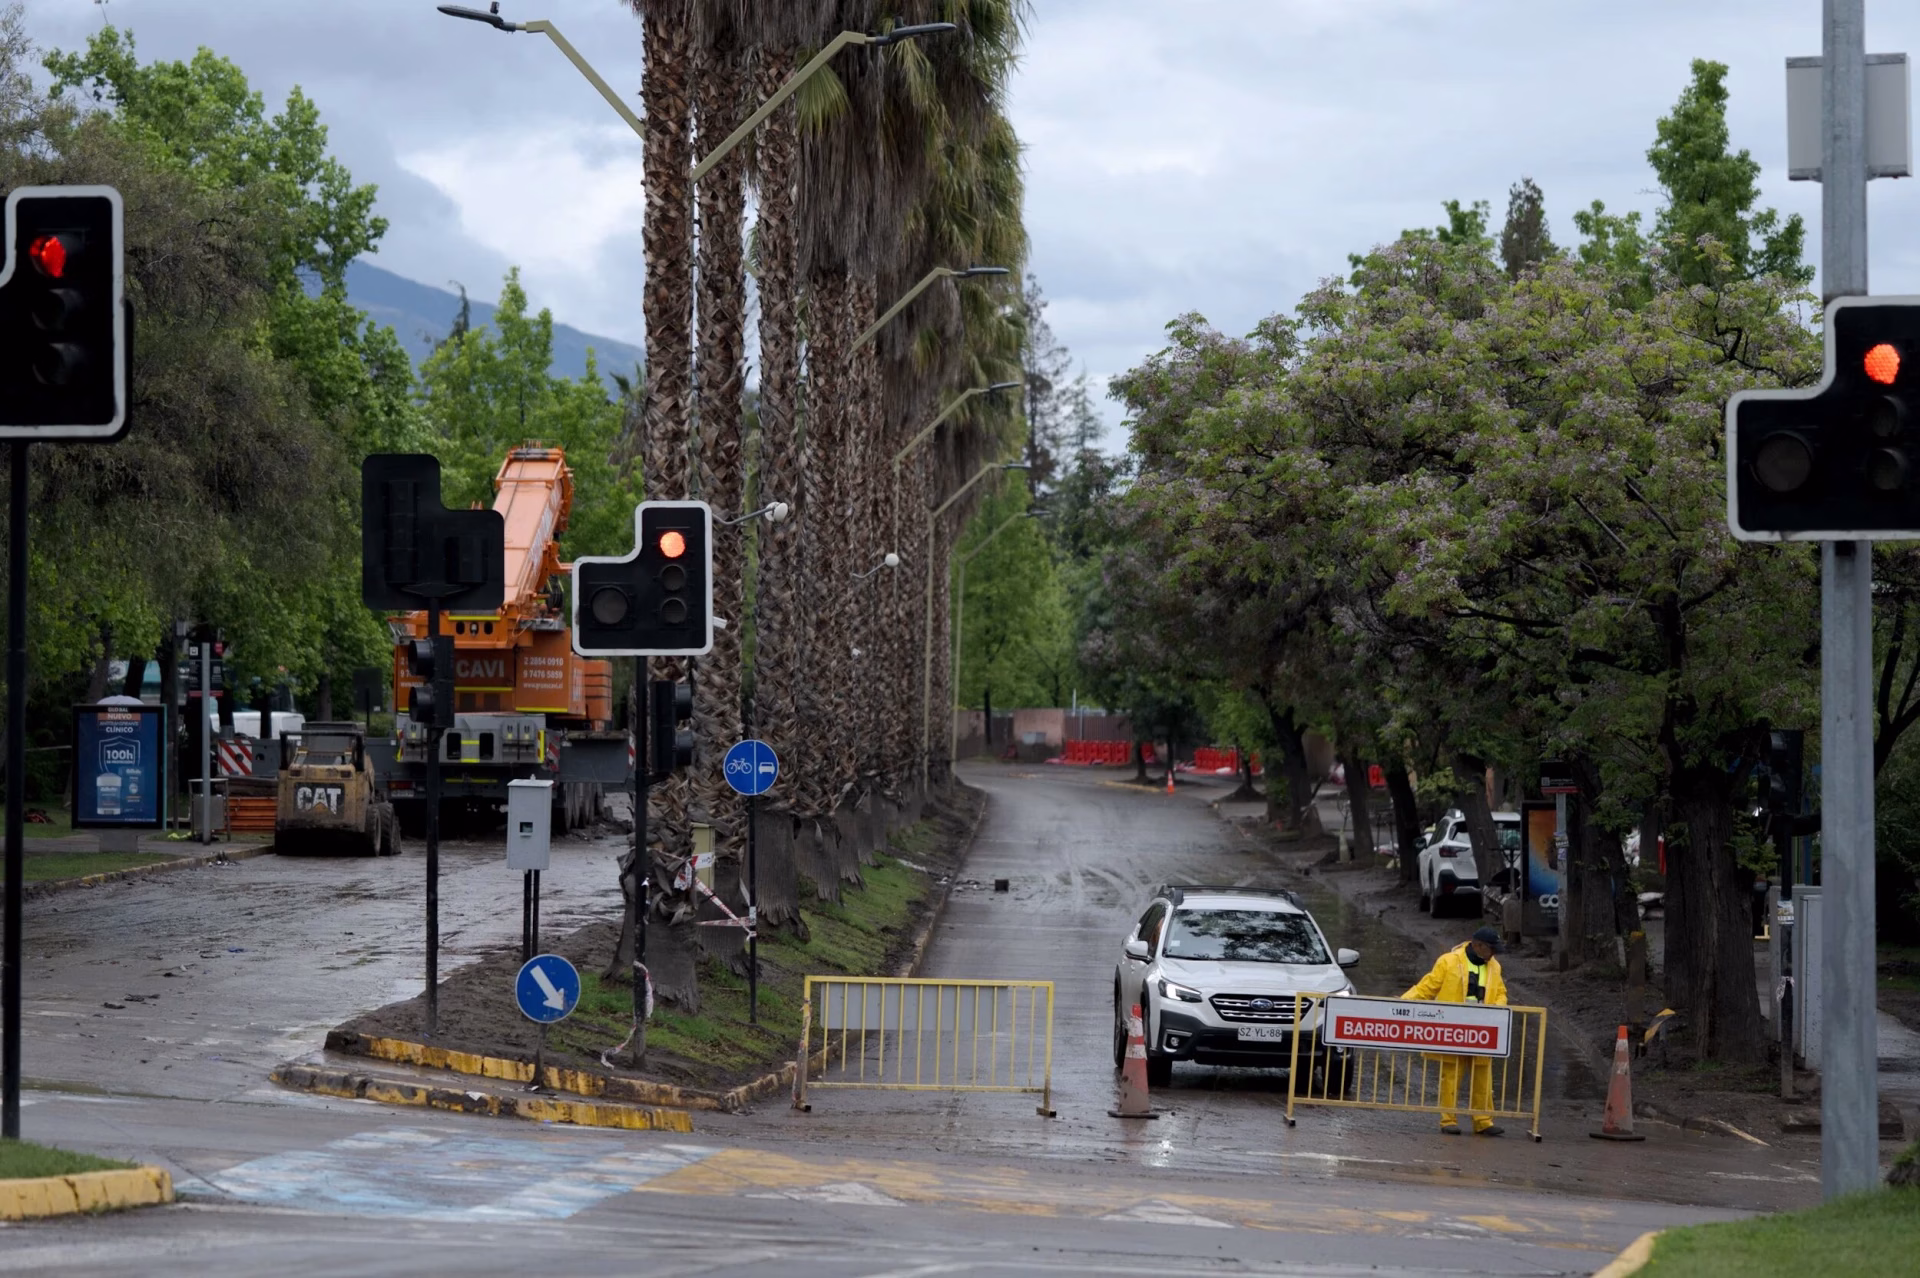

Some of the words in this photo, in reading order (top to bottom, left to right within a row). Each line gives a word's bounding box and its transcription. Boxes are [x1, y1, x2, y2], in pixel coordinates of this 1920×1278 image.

[456, 660, 504, 678] CAVI
[522, 670, 528, 678] 9
[106, 750, 133, 760] 100h
[297, 786, 342, 814] CAT
[1344, 1021, 1400, 1039] BARRIO
[1404, 1025, 1489, 1044] PROTEGIDO
